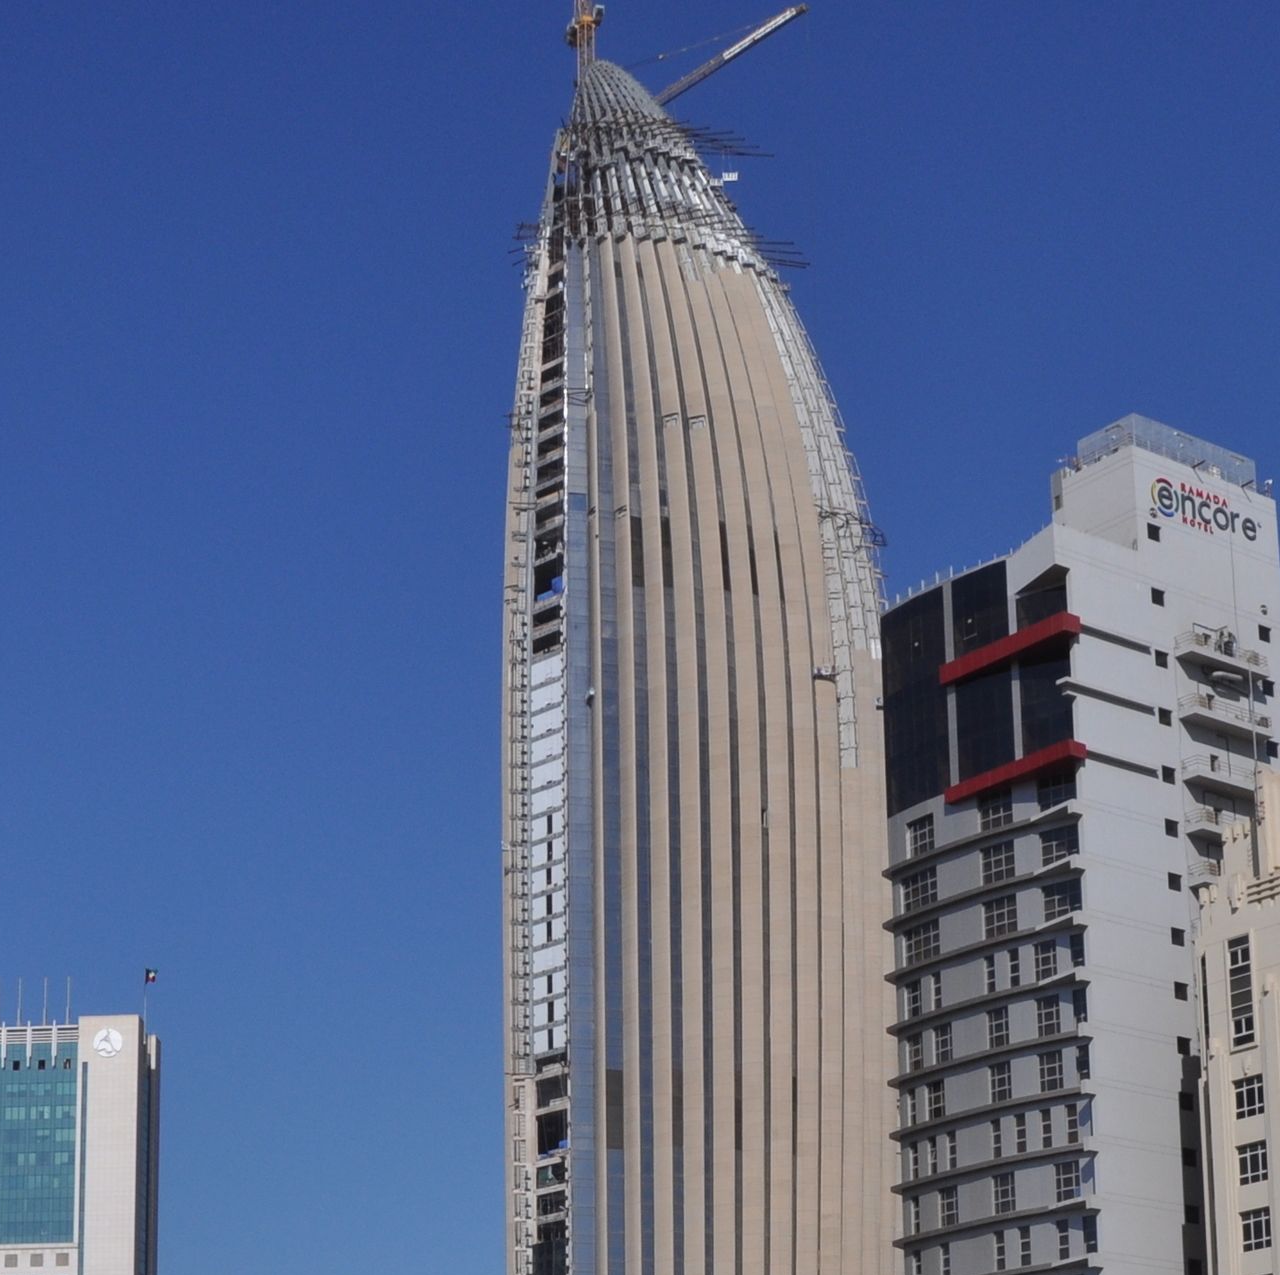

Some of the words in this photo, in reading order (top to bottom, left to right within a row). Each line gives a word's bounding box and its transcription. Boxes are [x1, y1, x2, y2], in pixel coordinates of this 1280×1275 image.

[1180, 482, 1228, 508] RAMADA
[1157, 486, 1257, 541] encore
[1182, 516, 1214, 535] HOTEL
